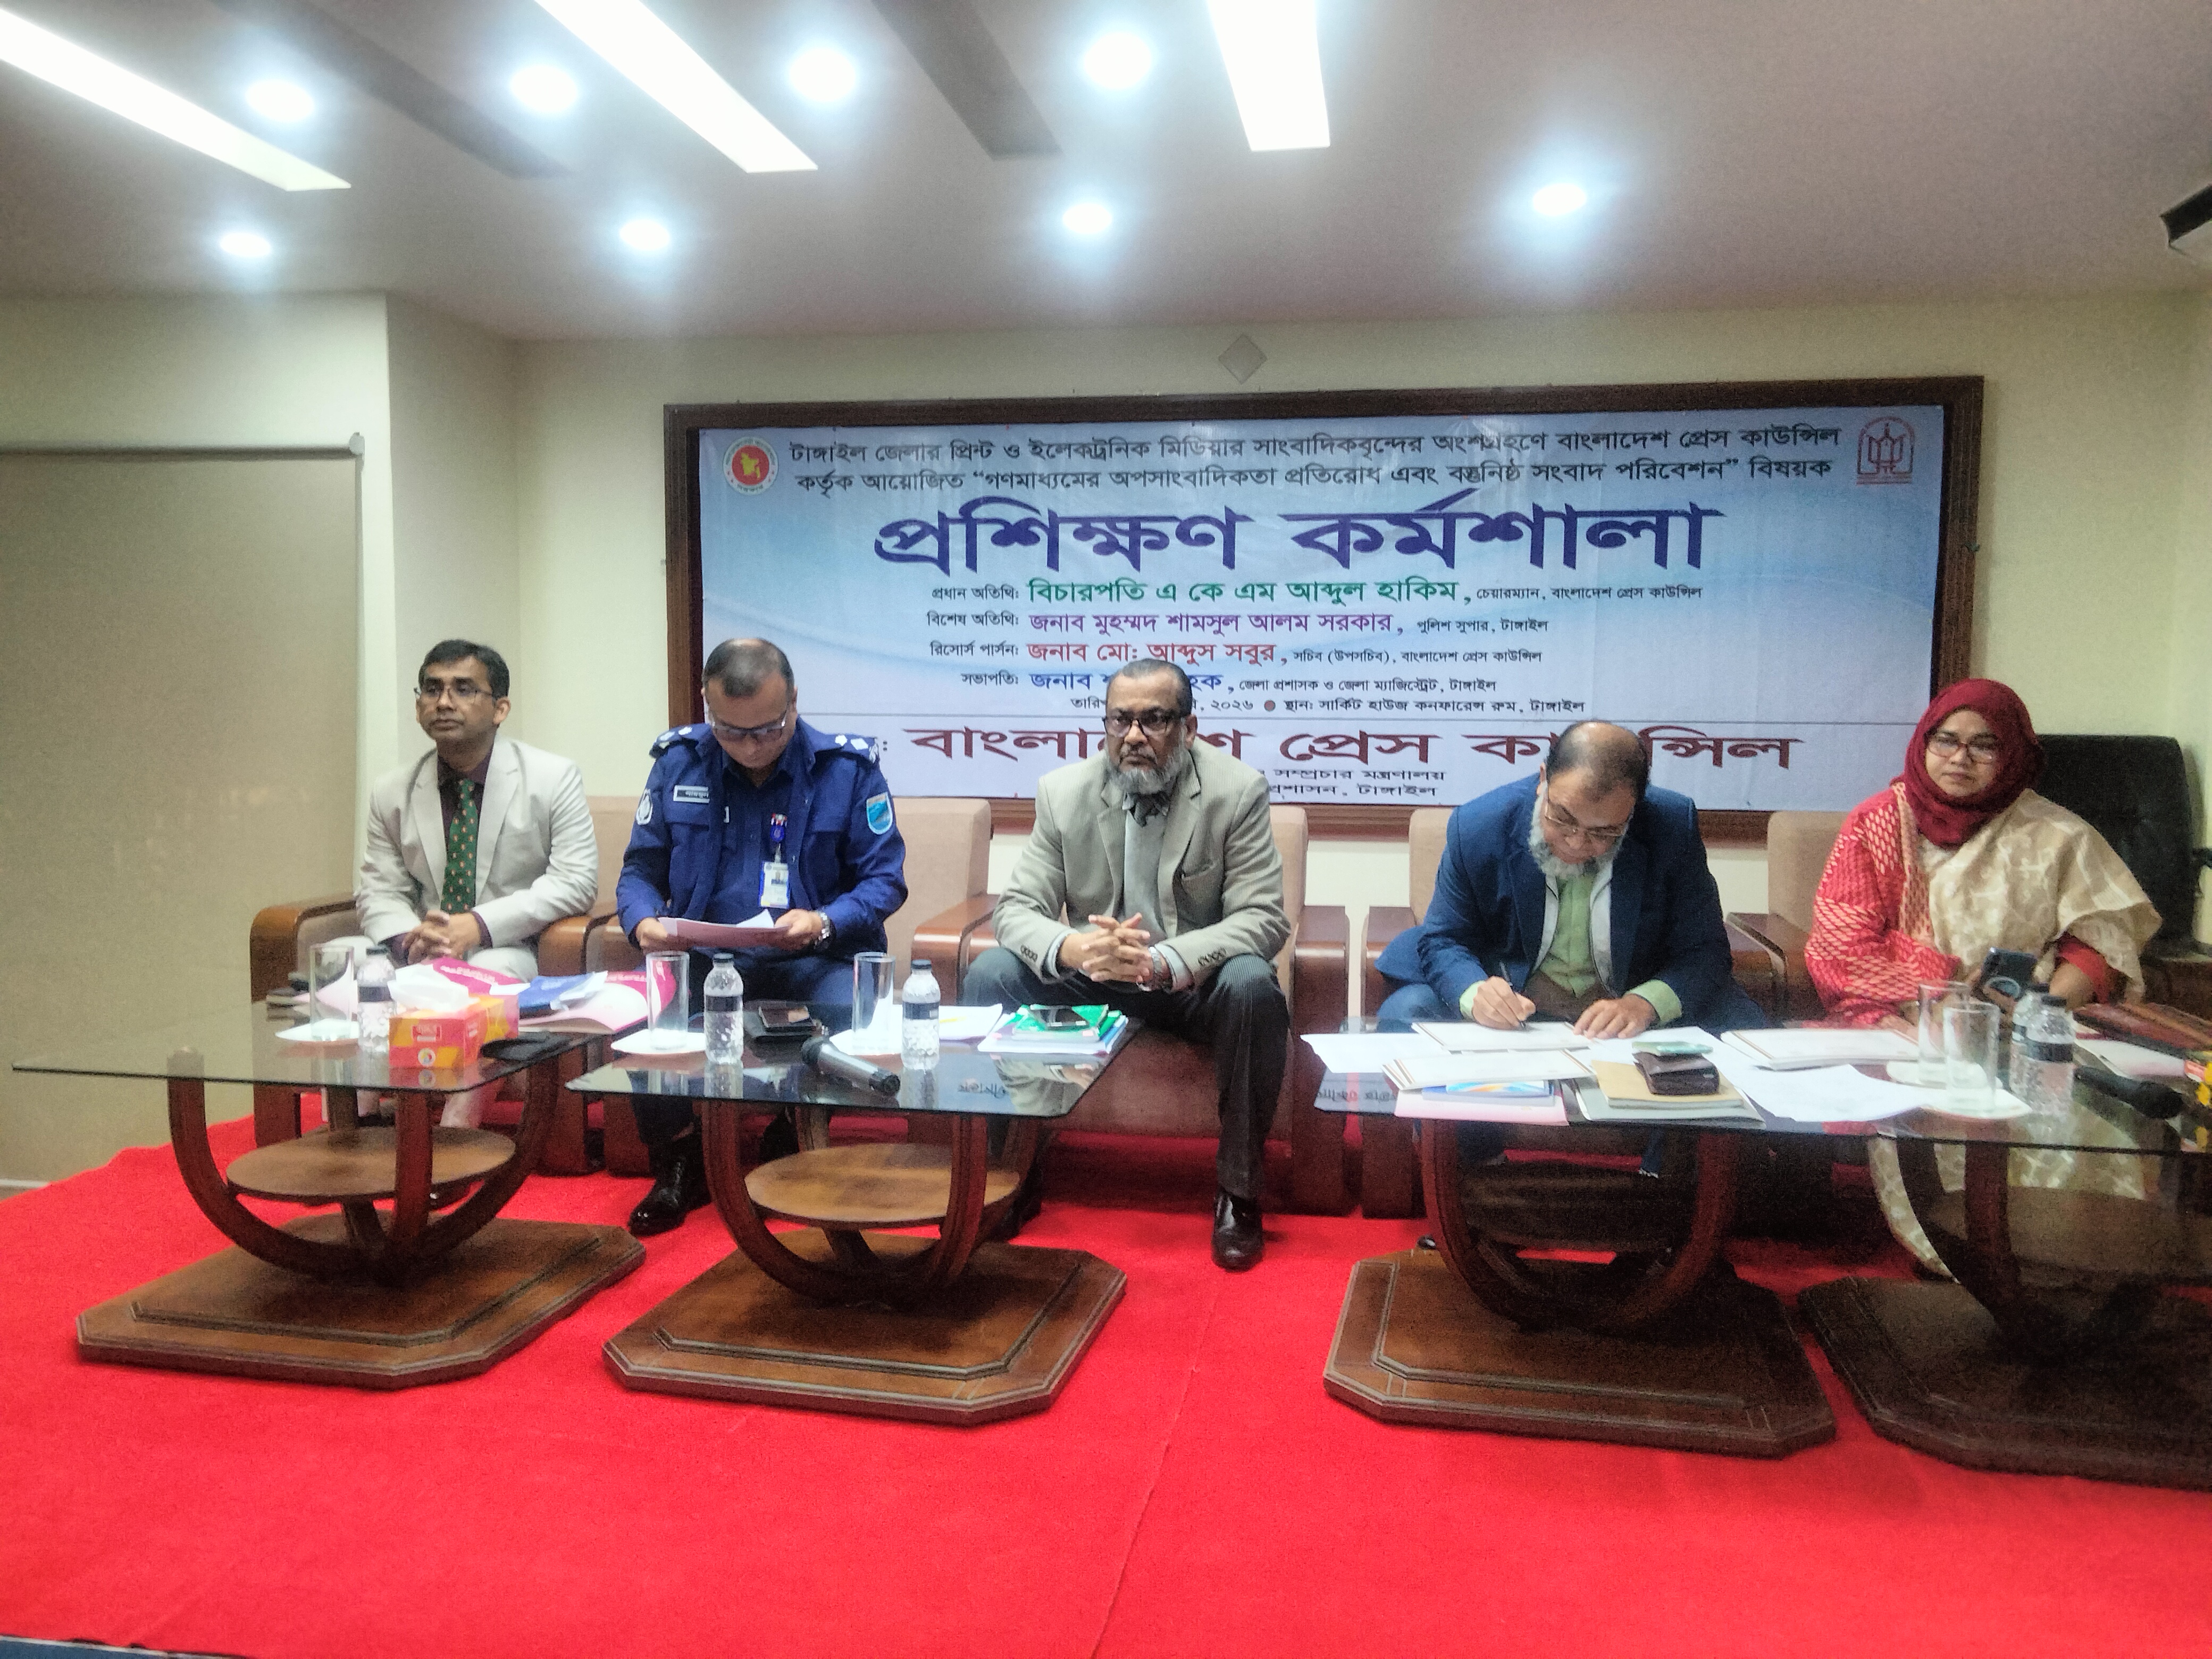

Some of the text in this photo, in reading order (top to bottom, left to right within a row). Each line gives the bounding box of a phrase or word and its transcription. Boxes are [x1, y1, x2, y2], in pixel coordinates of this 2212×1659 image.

[788, 440, 868, 465] টাঙ্গাইল
[875, 441, 942, 463] জেলার
[949, 438, 996, 462] প্রিন্ট
[1002, 444, 1020, 459] ও
[1027, 435, 1152, 462] ইলেকট্রনিক
[1158, 433, 1246, 459] মিডিয়ার
[1250, 431, 1426, 463] সাংবাদিকবৃন্দের
[1555, 428, 1672, 453] বাংলাদেশ
[1679, 428, 1733, 449] প্রেস
[1738, 421, 1842, 448] কাউন্সিল
[794, 468, 855, 499] কর্তৃক
[859, 467, 967, 492] আয়োজিত
[1107, 463, 1279, 489] অপসাংবাদিকতা
[1284, 460, 1385, 487] প্রতিরোধ
[1390, 466, 1439, 485] এবং
[1529, 462, 1607, 483] সংবাদ
[1746, 453, 1834, 479] বিষয়ক
[874, 487, 1727, 576] প্রশিক্ষণ কর্মশালা
[931, 586, 968, 601] প্রধান
[1026, 576, 1148, 604] বিচারপতি
[1155, 583, 1177, 602] এ
[1188, 582, 1225, 602] কে
[1234, 582, 1278, 602] এম
[1285, 581, 1368, 607] আব্দুল
[1550, 586, 1613, 601] বাংলাদেশ
[1616, 586, 1646, 600] প্রেস
[1647, 583, 1704, 599] কাউন্সিল
[926, 610, 967, 627] বিশেষ
[1028, 613, 1087, 633] জনাব
[1092, 614, 1160, 637] মুহম্মদ
[1165, 612, 1242, 638] শামসুল
[1247, 613, 1312, 633] আলম
[1417, 617, 1452, 635] পুলিশ
[1499, 616, 1549, 632] টাঙ্গাইল
[929, 639, 976, 657] রিসোর্স
[1025, 642, 1090, 663] জনাব
[1144, 642, 1218, 668] আব্দুস
[1292, 648, 1324, 663] সচিব
[1400, 651, 1459, 663] বাংলাদেশ
[1462, 650, 1488, 663] প্রেস
[1492, 648, 1543, 663] কাউন্সিল
[1028, 671, 1094, 690] জনাব
[1239, 679, 1270, 691] জেলা
[1273, 678, 1319, 691] প্রশাসক
[1323, 681, 1334, 691] ও
[1338, 679, 1370, 692] জেলা
[1448, 677, 1497, 692] টাঙ্গাইল
[1069, 696, 1108, 710] তারি
[1210, 699, 1254, 711] ২০২৬
[1318, 697, 1363, 711] সার্কিট
[1367, 697, 1409, 711] হাউজ
[1413, 700, 1486, 712] কনফারেন্স
[1529, 698, 1586, 713] টাঙ্গাইল
[902, 725, 1804, 770] বাংলাশ প্রেস কন্সিল
[1356, 783, 1436, 797] টাঙ্গাইল
